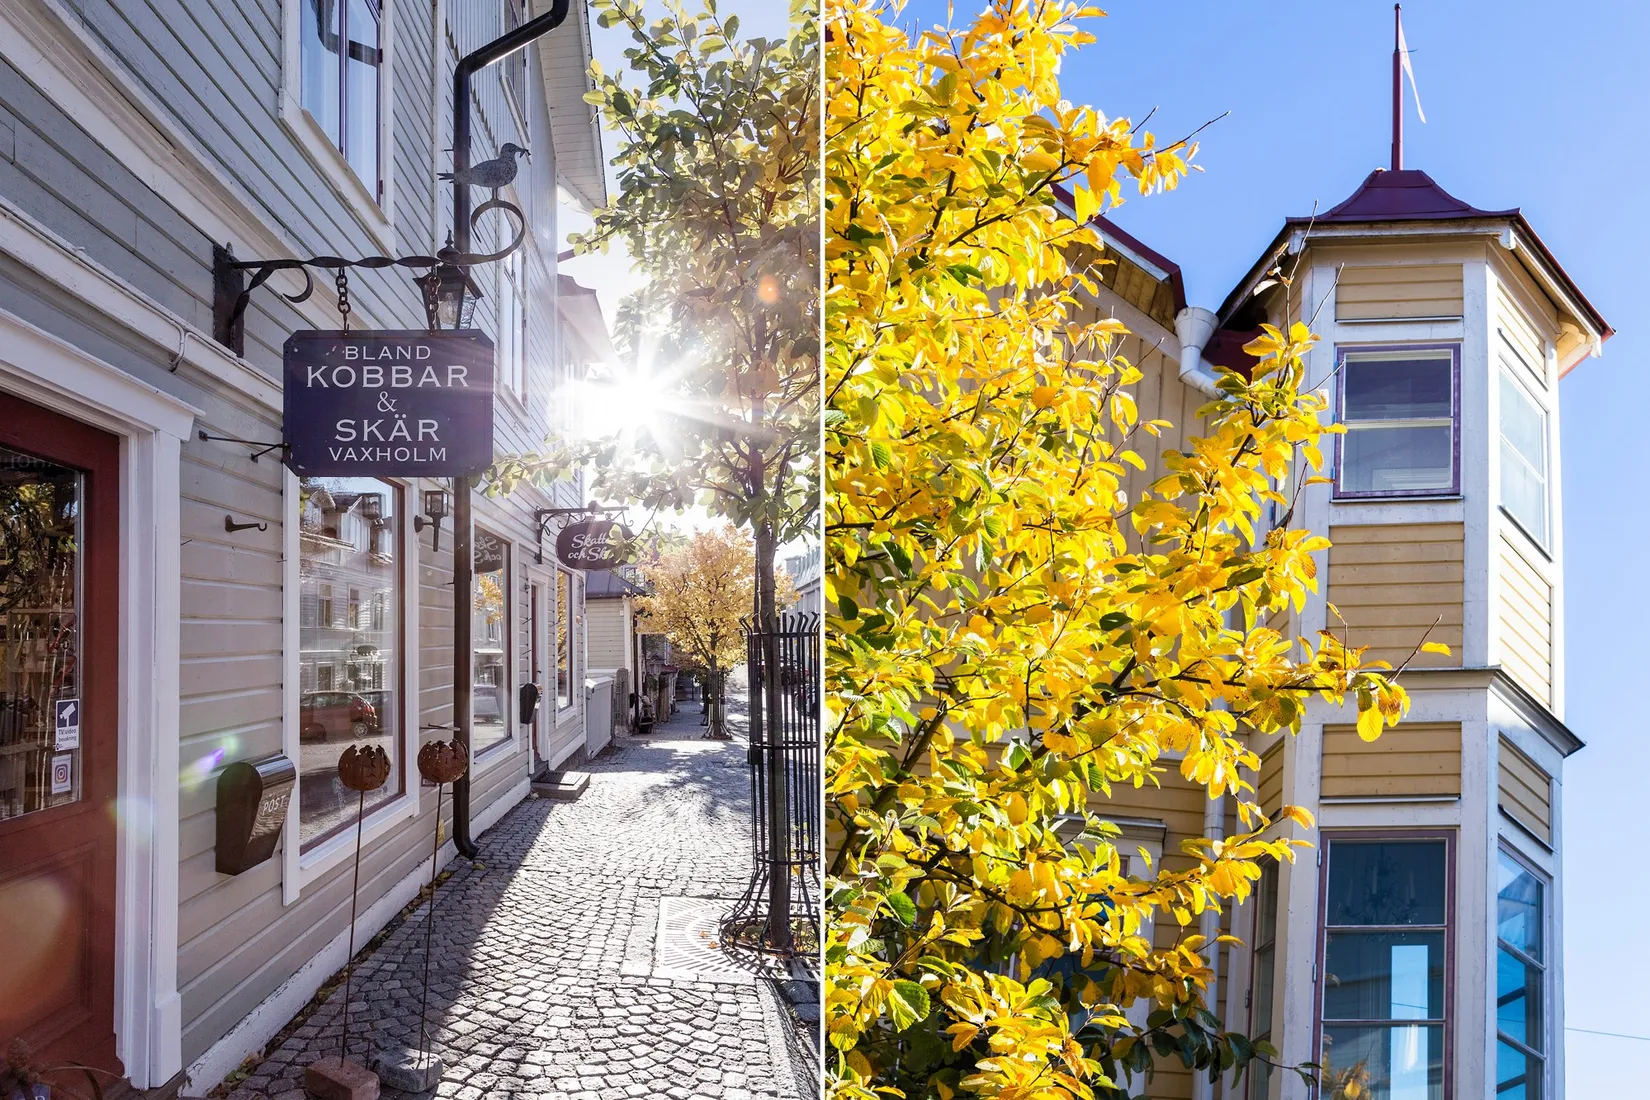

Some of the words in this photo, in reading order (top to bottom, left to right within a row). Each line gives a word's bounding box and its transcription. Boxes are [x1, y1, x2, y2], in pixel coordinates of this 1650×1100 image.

[344, 346, 431, 360] BLAND
[306, 365, 468, 388] KOBBAR
[376, 391, 397, 412] &
[335, 414, 439, 442] SKÄR
[329, 447, 446, 462] VAXHOLM
[567, 547, 587, 560] och
[262, 794, 287, 816] POST
